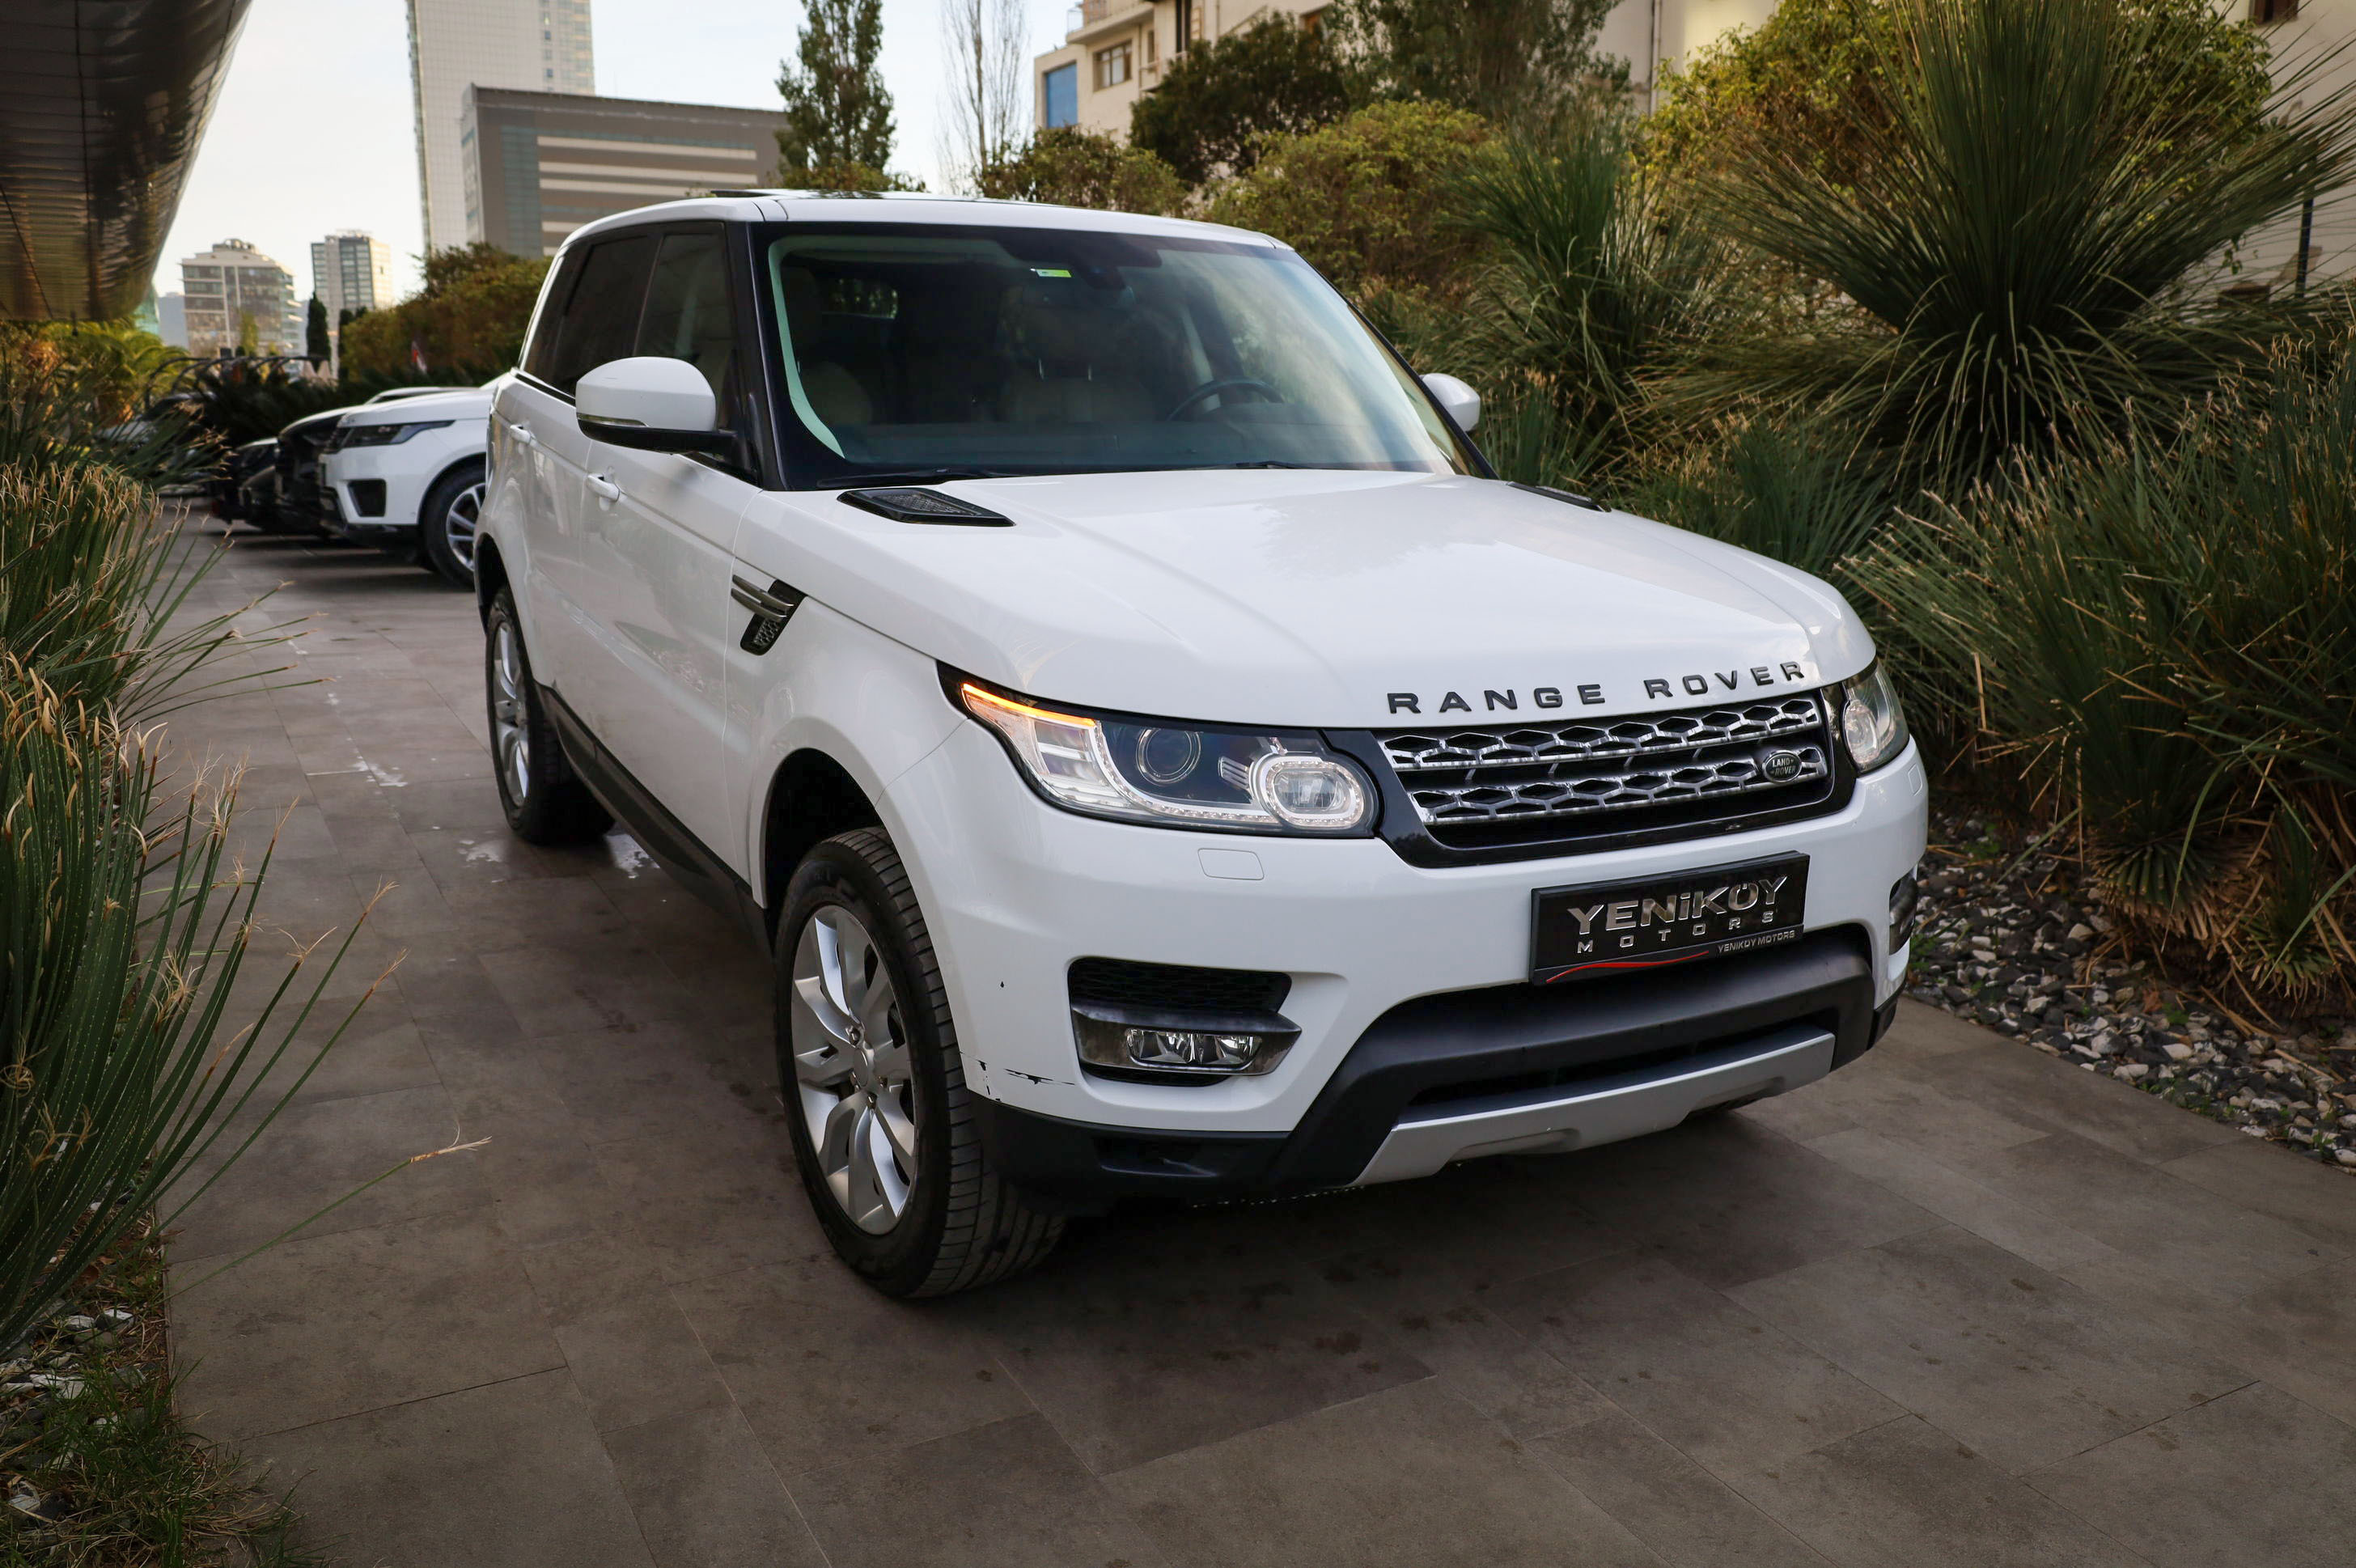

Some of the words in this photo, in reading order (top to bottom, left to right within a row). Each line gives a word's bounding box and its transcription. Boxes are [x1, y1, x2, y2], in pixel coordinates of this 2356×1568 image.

[1387, 684, 1606, 714] RANGE
[1643, 661, 1805, 699] ROVER
[1772, 757, 1790, 768] LAND
[1774, 765, 1796, 776] ROVER
[1577, 910, 1774, 954] MOTORS
[1757, 930, 1795, 946] MOTORS
